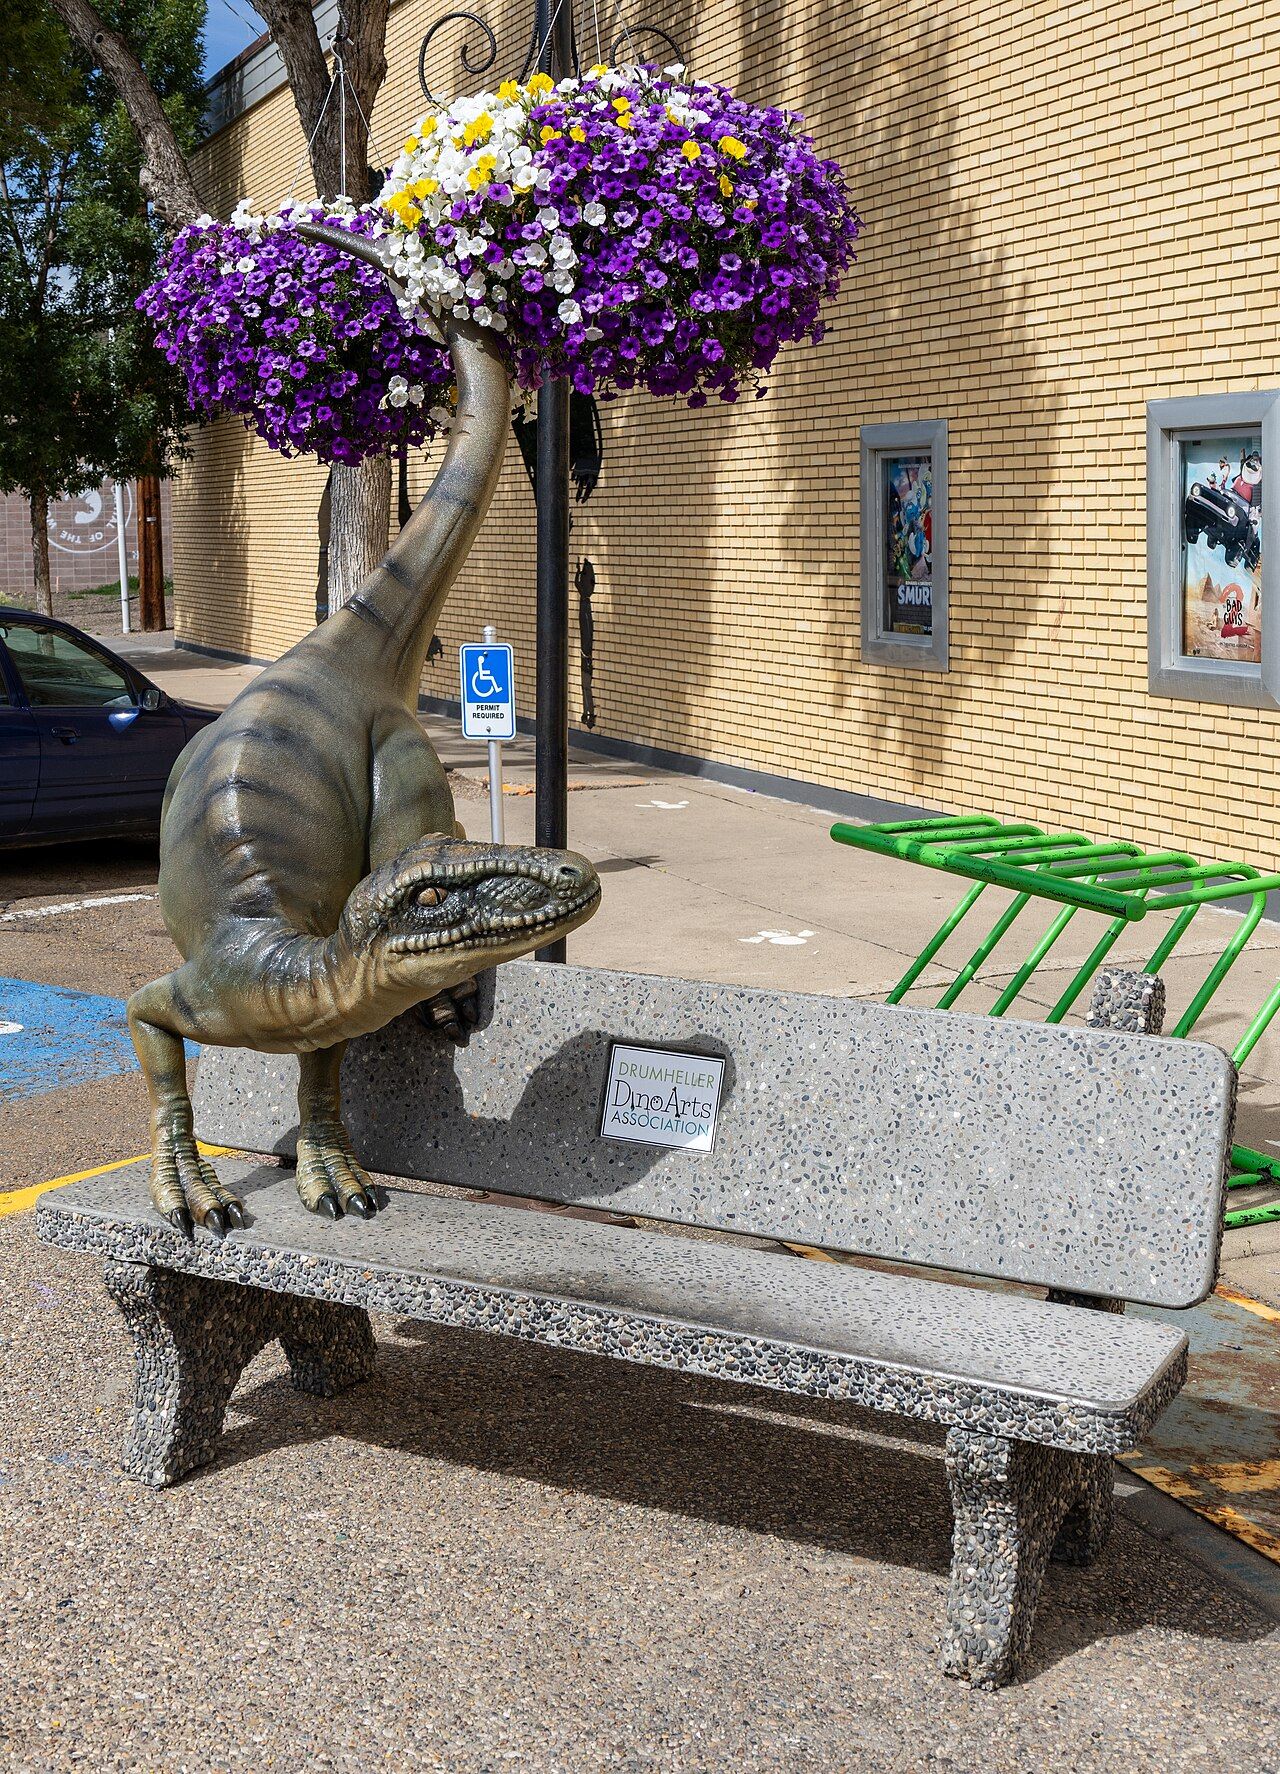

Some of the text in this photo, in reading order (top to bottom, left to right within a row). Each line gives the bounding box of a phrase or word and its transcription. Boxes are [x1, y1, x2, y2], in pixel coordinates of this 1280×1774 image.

[60, 530, 103, 544] OF THE
[1219, 583, 1249, 638] 2
[1226, 599, 1242, 612] BAD
[1223, 612, 1243, 626] GUYS
[618, 1061, 715, 1089] DRUMHELLER
[611, 1110, 710, 1137] ASSOCIATION
